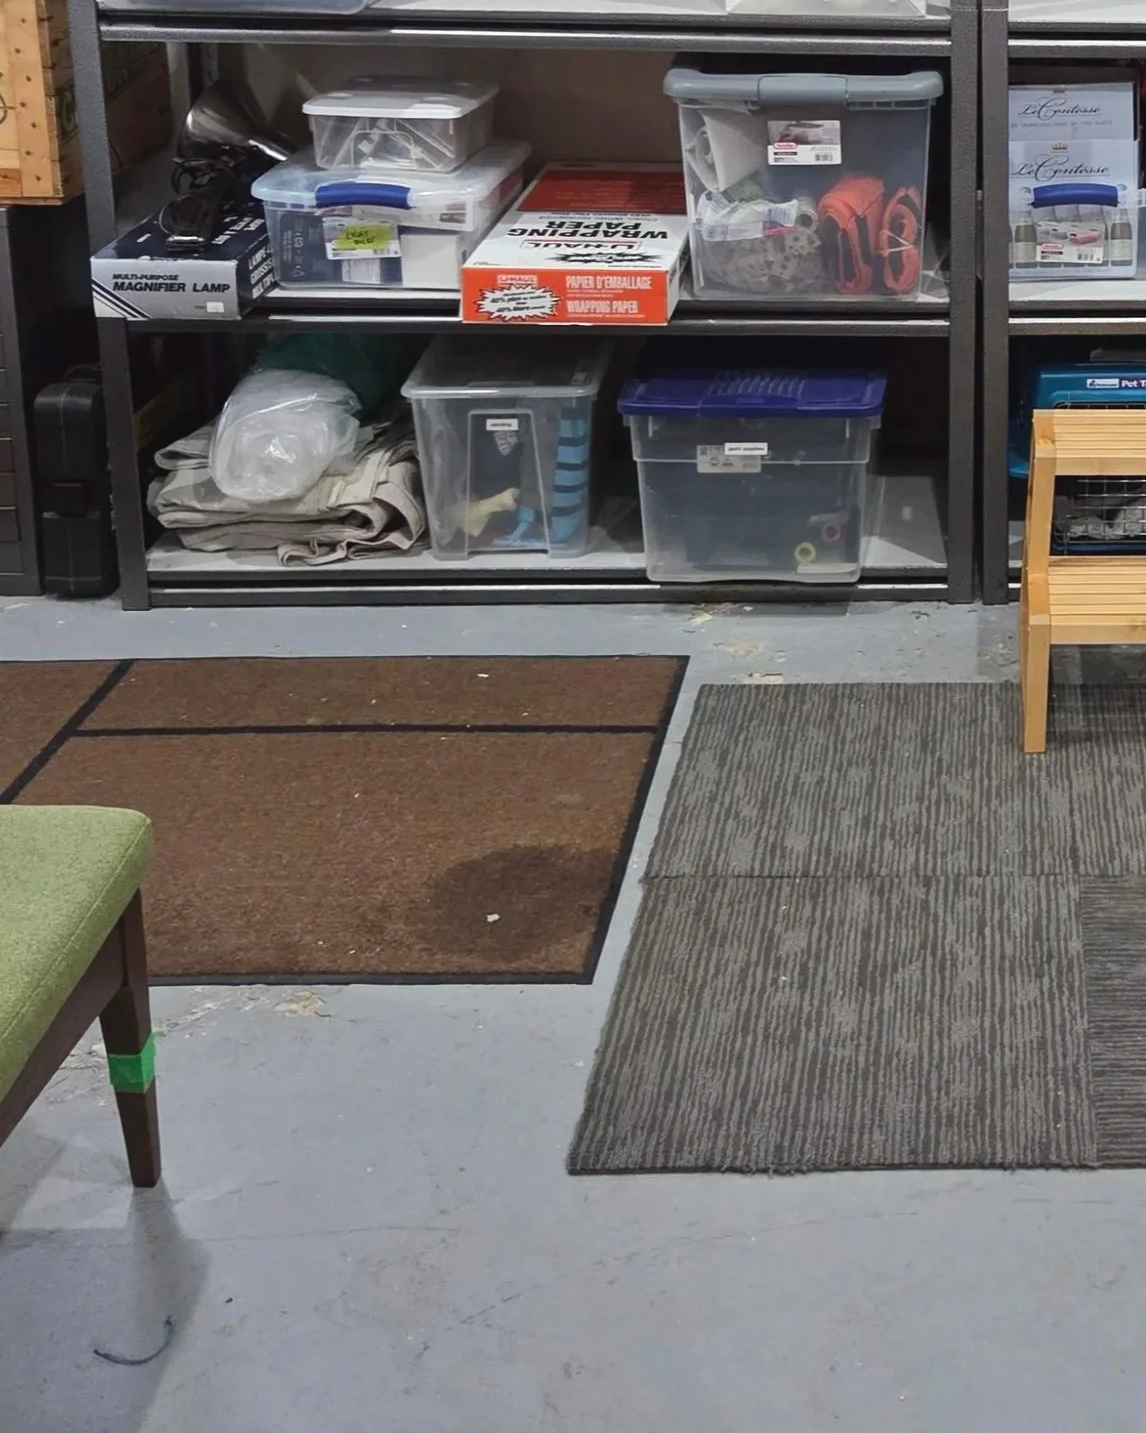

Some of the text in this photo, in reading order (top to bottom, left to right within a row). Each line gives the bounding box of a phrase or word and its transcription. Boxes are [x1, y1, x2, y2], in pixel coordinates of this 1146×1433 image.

[545, 220, 642, 230] PAPER
[507, 227, 668, 240] WRAPPING
[525, 241, 635, 251] U-HAUL
[112, 273, 180, 282] MULTI-PURPOSE
[565, 275, 652, 290] PAPIER D'EMBALLAGE
[112, 281, 231, 294] MAGNIFIER LAMP
[567, 300, 639, 314] WRAPPING PAPER
[1121, 379, 1138, 388] Pet
